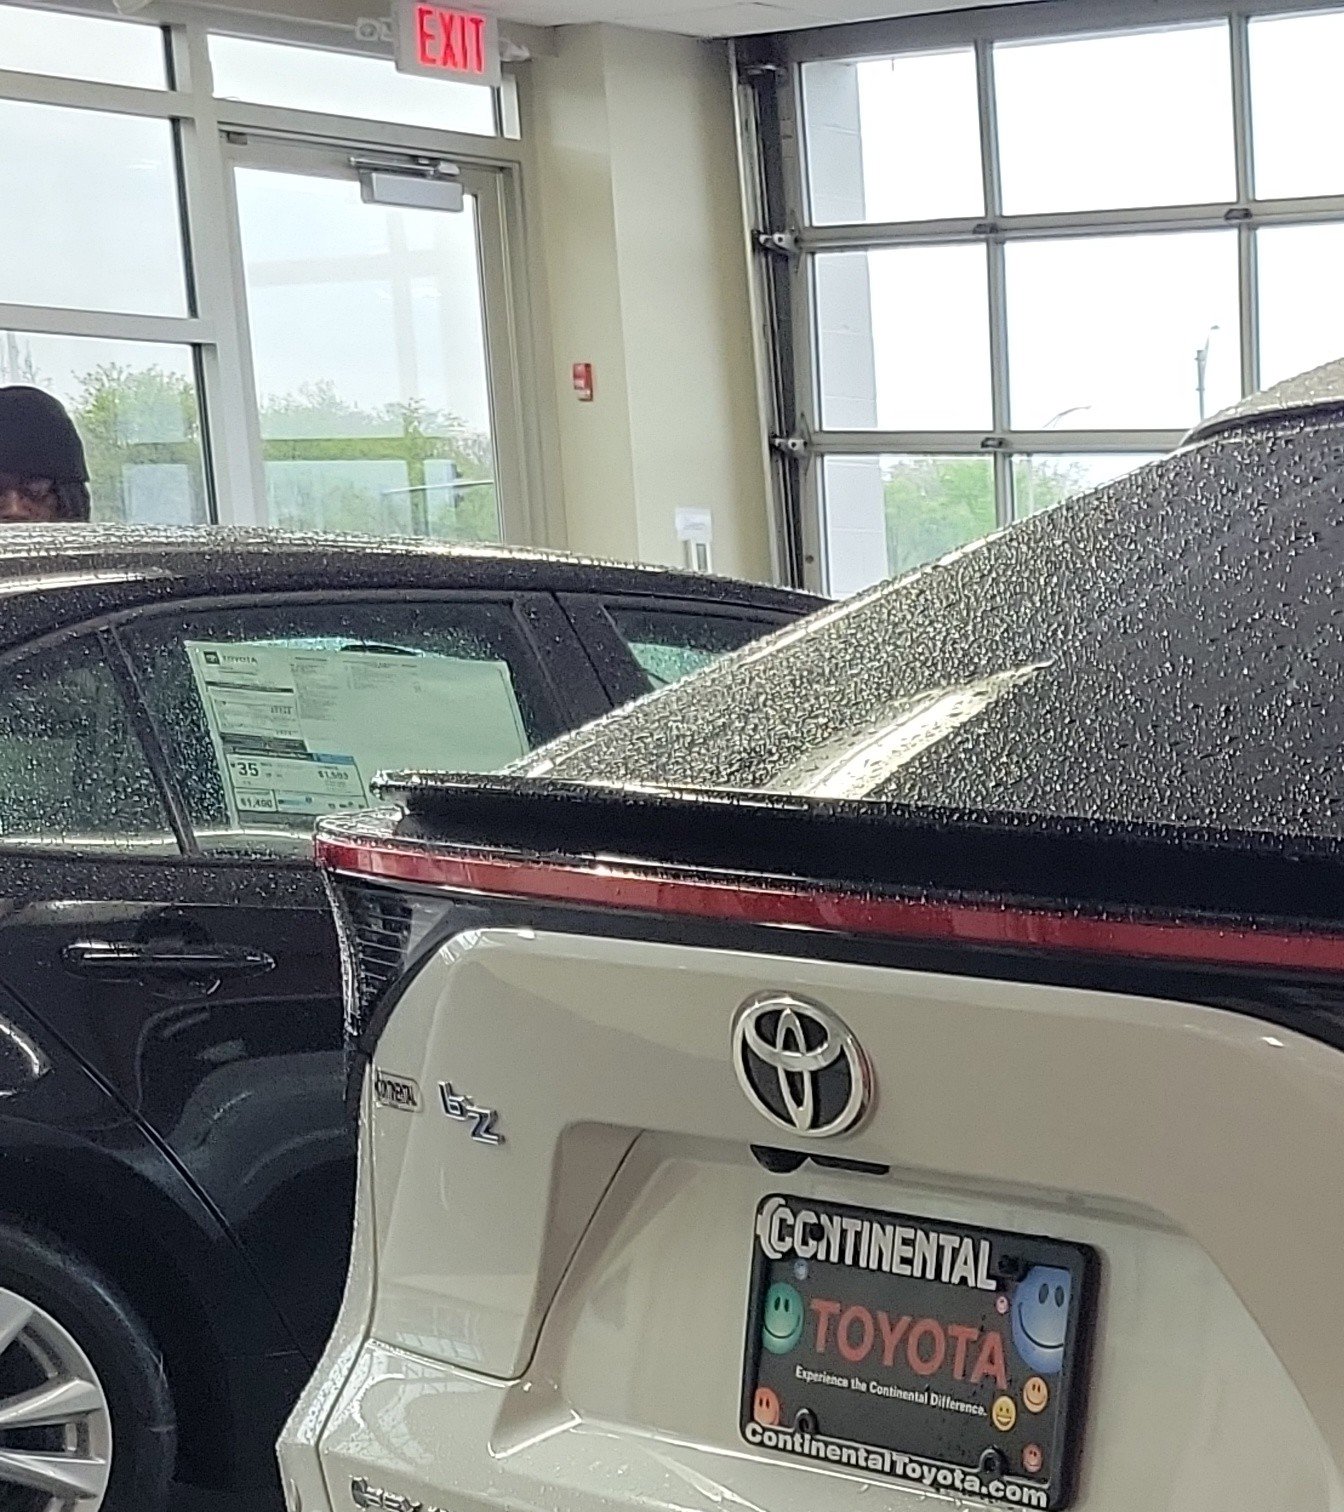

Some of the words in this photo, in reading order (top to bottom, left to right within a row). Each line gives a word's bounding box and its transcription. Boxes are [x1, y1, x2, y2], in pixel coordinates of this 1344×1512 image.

[417, 6, 485, 74] EXIT
[237, 762, 259, 777] 35
[756, 1197, 998, 1291] CONTINENTAL
[809, 1299, 1009, 1390] TOYOTA
[795, 1364, 849, 1389] Experience
[850, 1376, 868, 1393] the
[869, 1380, 929, 1406] Continental
[930, 1392, 989, 1417] Difference.
[745, 1422, 1050, 1509] ContinentalToyota.com
